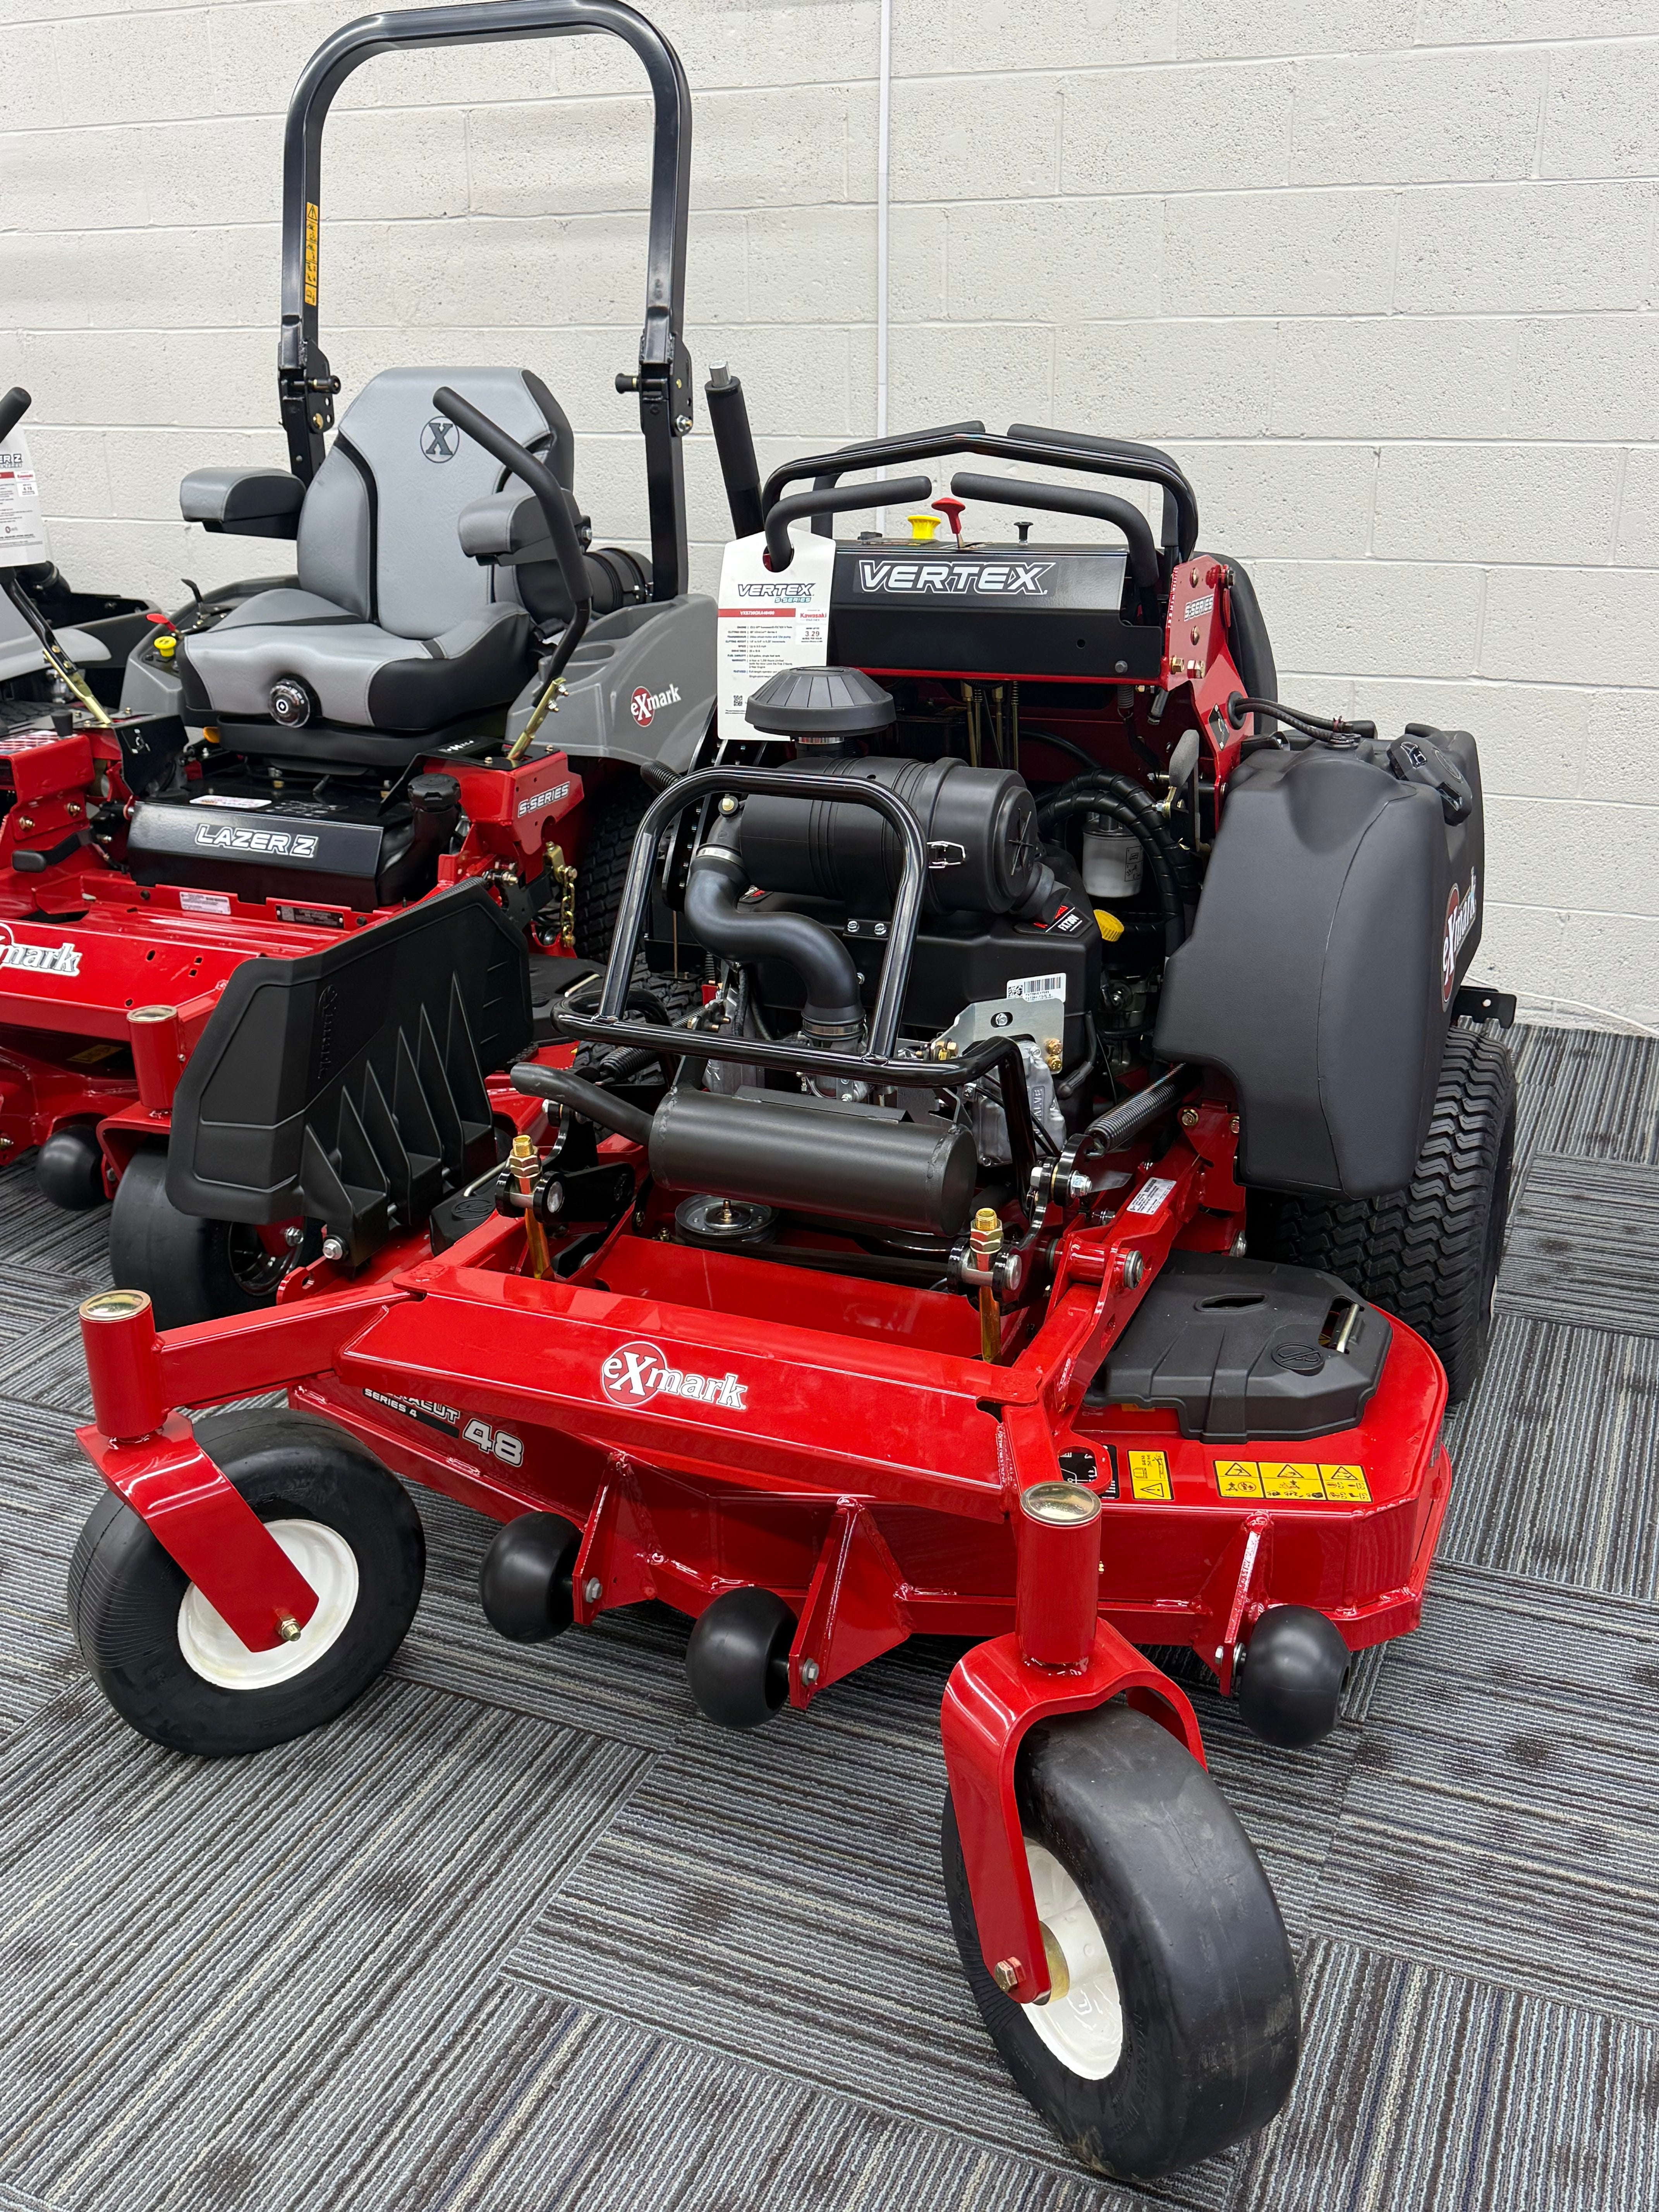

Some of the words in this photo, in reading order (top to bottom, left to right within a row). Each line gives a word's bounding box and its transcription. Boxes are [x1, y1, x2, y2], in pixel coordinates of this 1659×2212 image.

[738, 583, 816, 597] VERTEX
[859, 560, 1056, 595] VERTEX
[1184, 593, 1214, 622] S-SERIES
[630, 683, 682, 721] eXmark
[518, 781, 570, 818] S-SERIES
[195, 823, 291, 856] LAZER
[289, 834, 319, 858] Z
[1443, 866, 1476, 986] eXmark
[0, 942, 83, 977] mark
[603, 1352, 749, 1411] eXmark
[364, 1388, 407, 1413] SERIES
[409, 1409, 417, 1418] 4
[462, 1418, 524, 1468] 48
